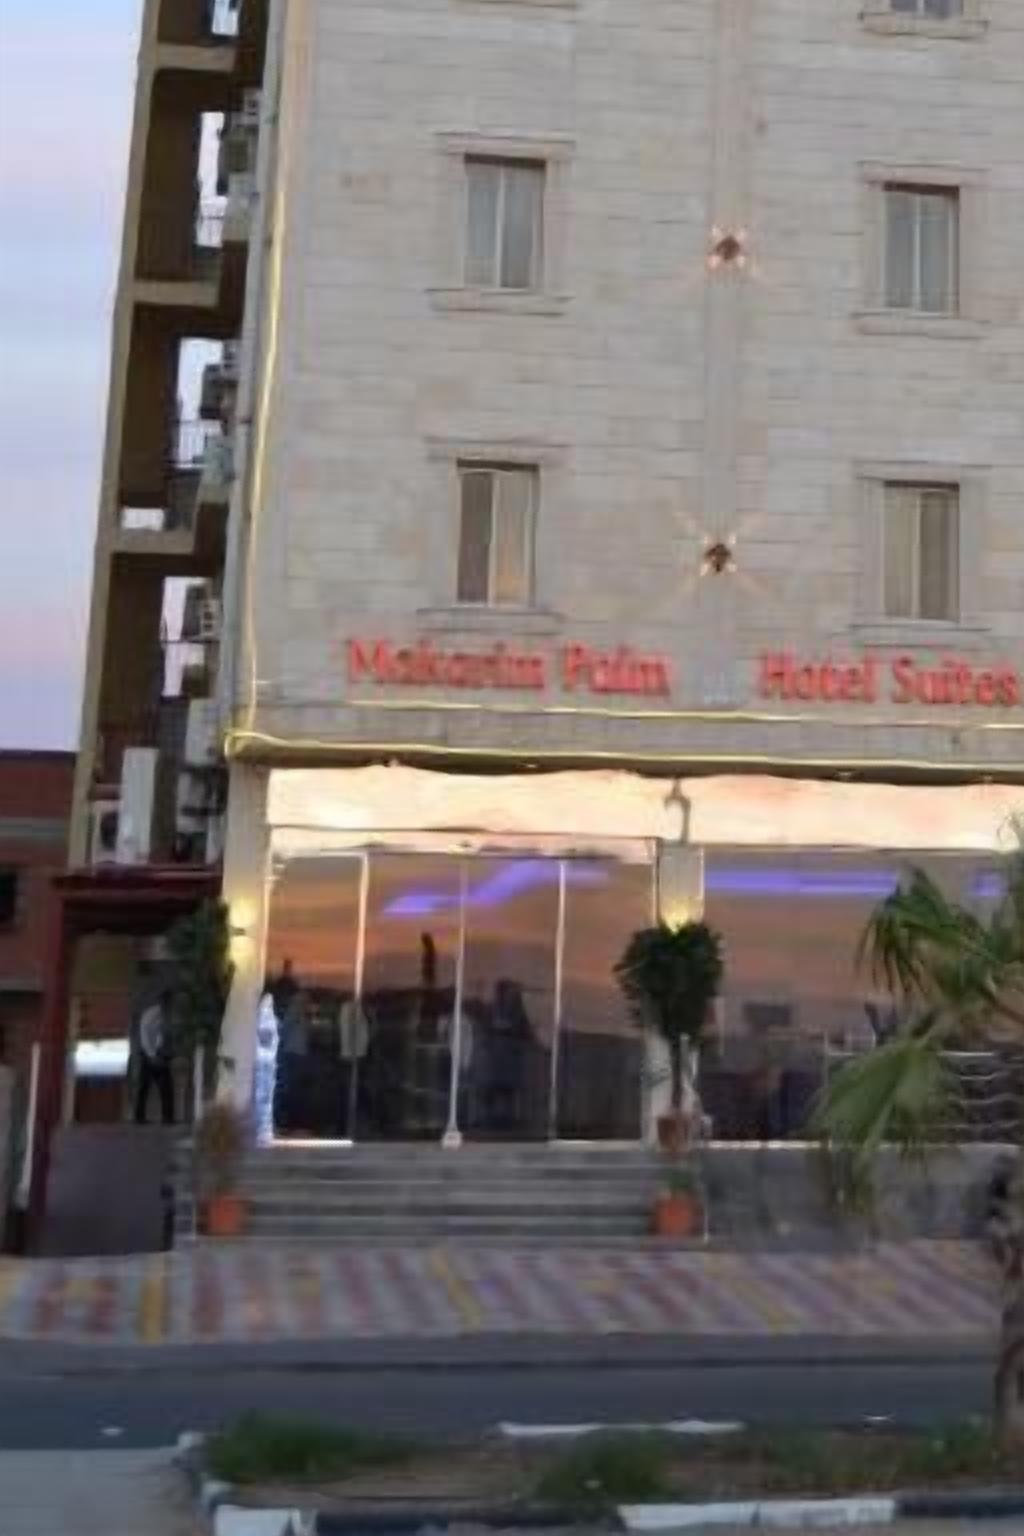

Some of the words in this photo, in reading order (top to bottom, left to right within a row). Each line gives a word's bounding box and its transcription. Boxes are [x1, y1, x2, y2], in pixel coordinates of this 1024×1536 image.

[347, 639, 545, 690] Makarim
[562, 640, 672, 696] Palm
[760, 649, 877, 703] Hotel
[890, 656, 1022, 706] Suites
